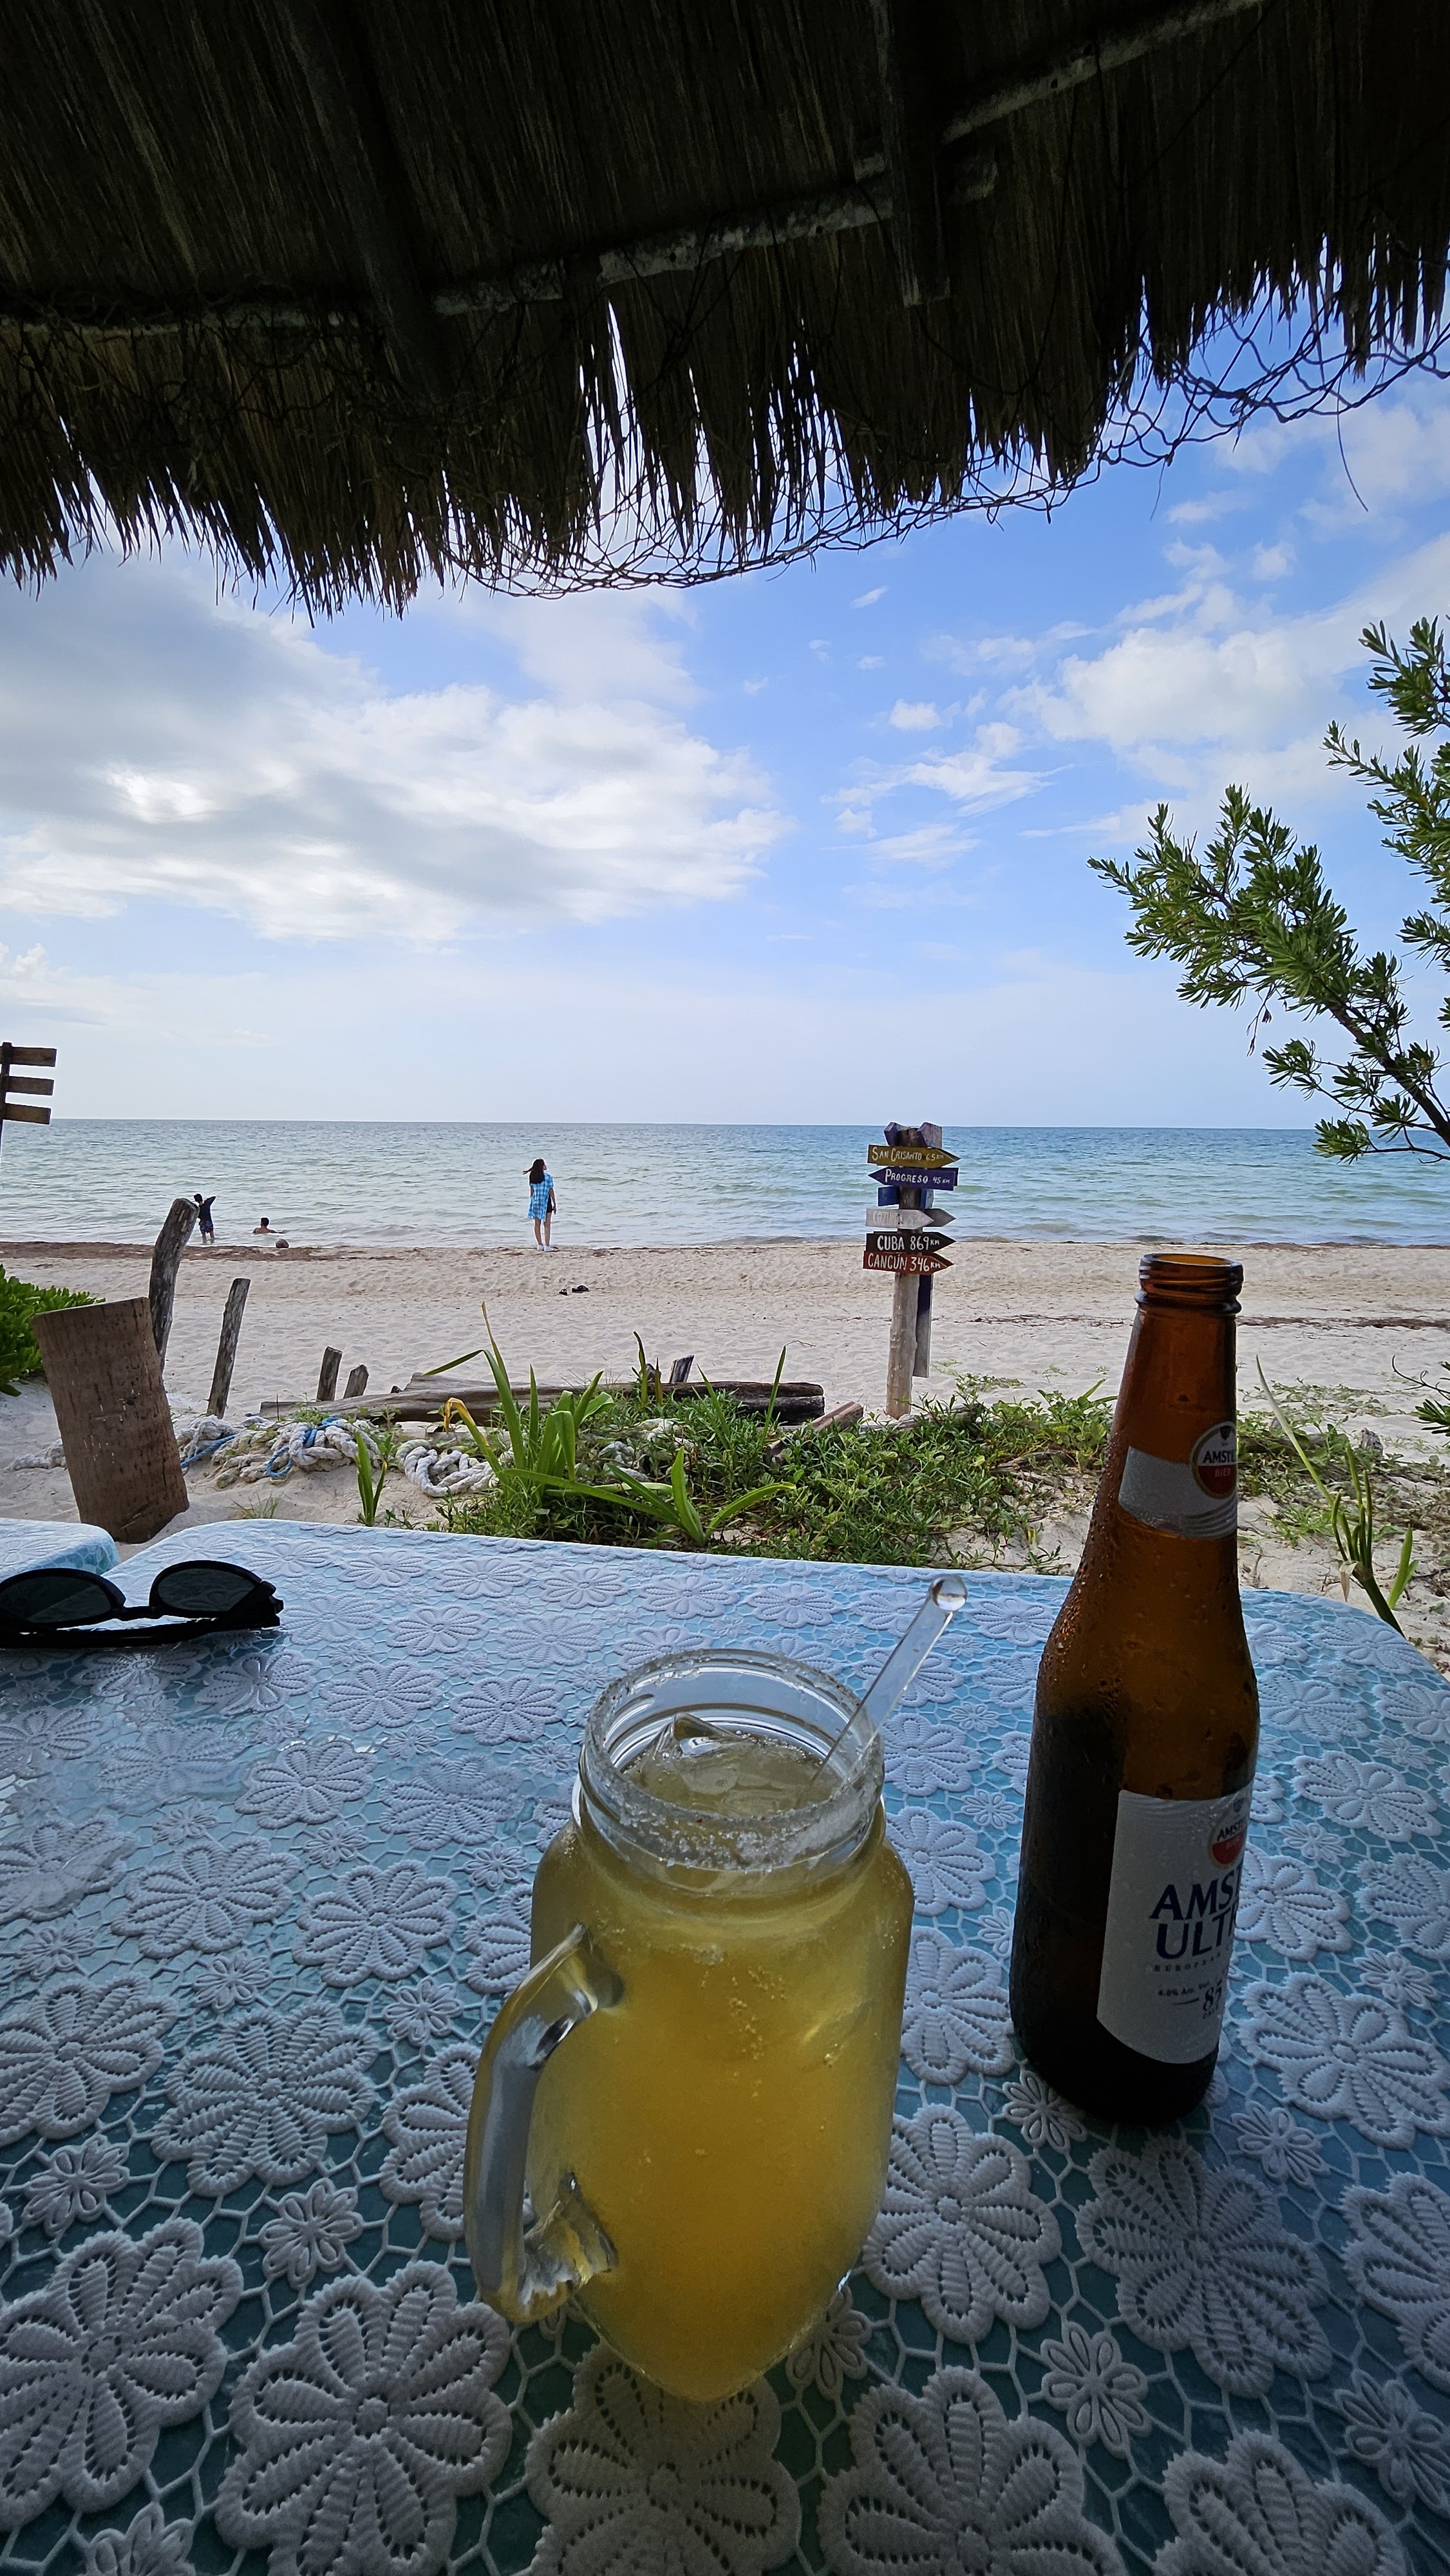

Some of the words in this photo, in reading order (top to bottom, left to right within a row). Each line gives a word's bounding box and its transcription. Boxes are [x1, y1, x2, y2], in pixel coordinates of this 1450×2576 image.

[885, 1168, 928, 1184] PROGRESO
[932, 1176, 941, 1184] 45
[877, 1235, 905, 1251] CUBA
[867, 1252, 908, 1271] CANCÚN
[1215, 1468, 1231, 1477] BIER
